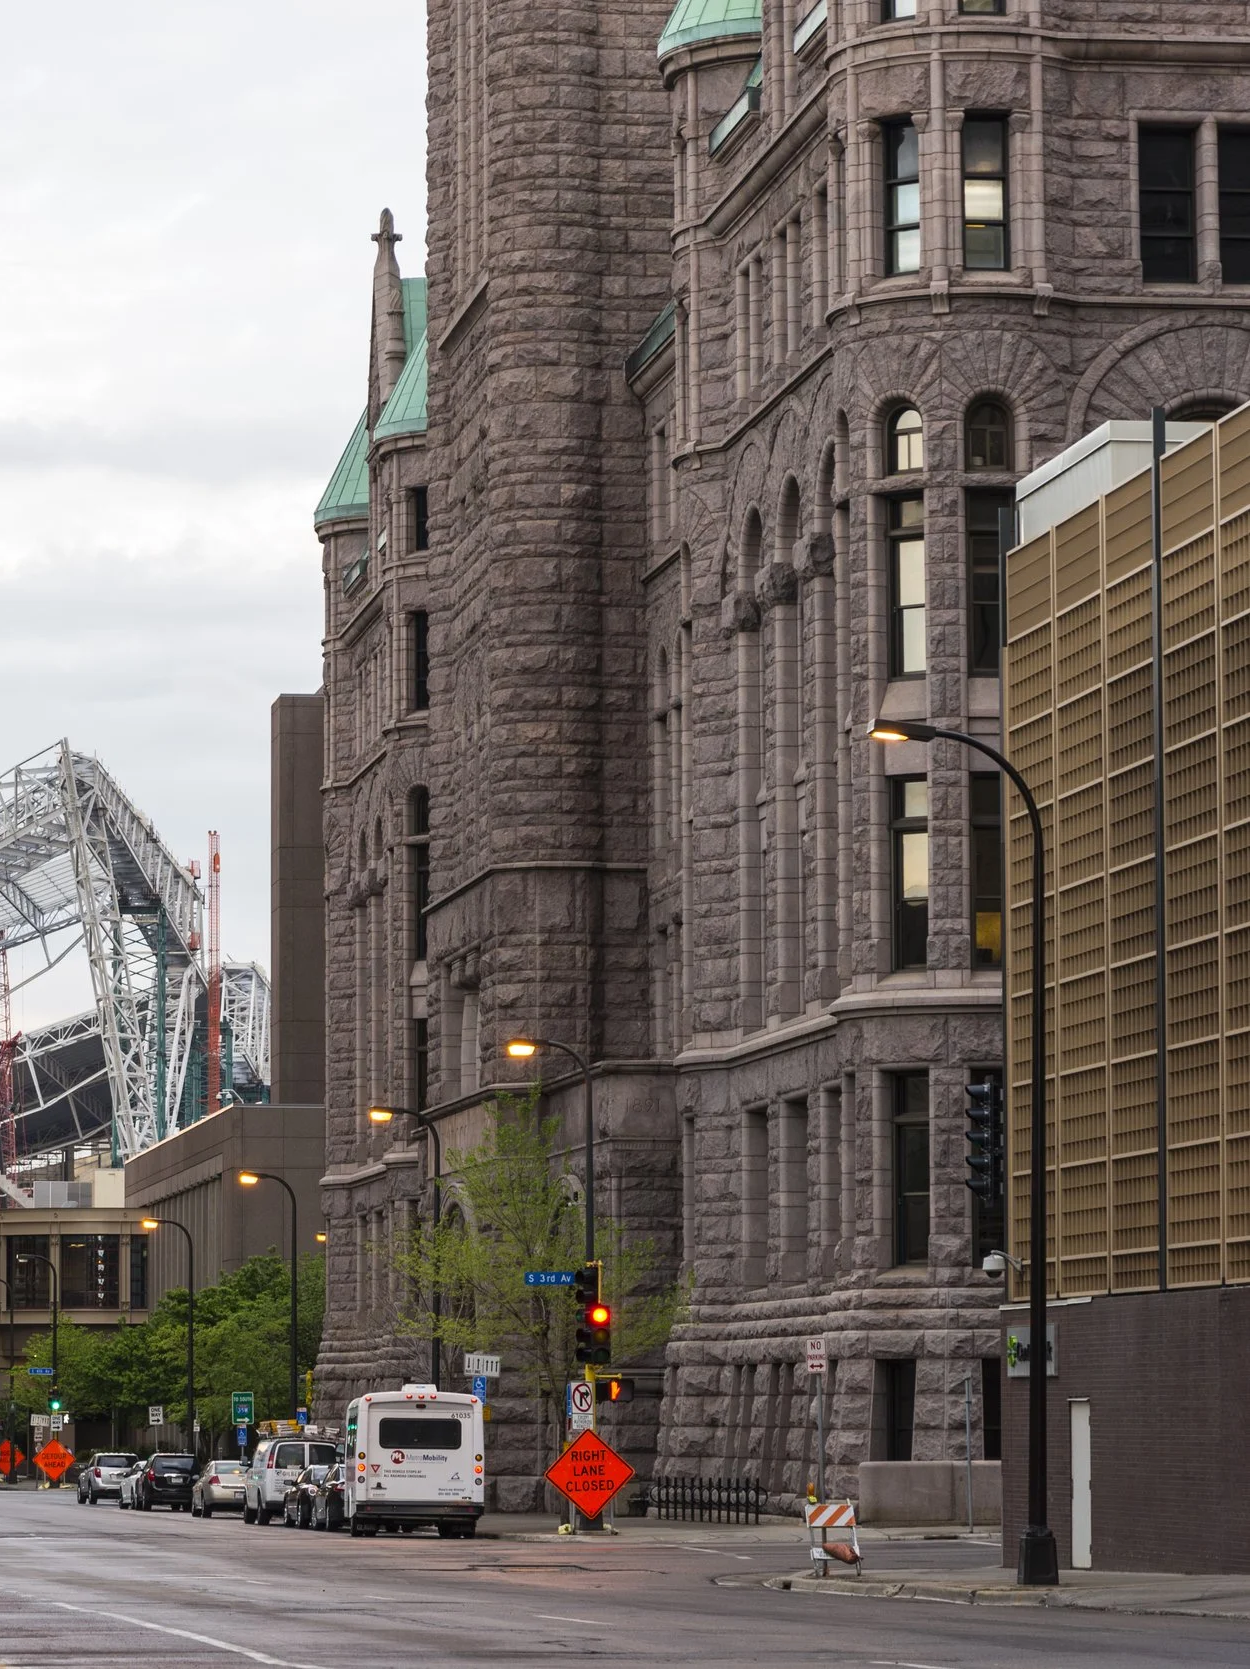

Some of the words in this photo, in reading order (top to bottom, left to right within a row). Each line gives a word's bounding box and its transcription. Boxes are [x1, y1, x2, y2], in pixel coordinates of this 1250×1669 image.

[528, 1274, 534, 1283] S
[540, 1274, 556, 1283] 3rd
[561, 1274, 571, 1283] Av
[810, 1341, 821, 1350] NO
[571, 1450, 606, 1461] RIGHT
[573, 1465, 605, 1476] LANE
[566, 1481, 615, 1491] CLOSED
